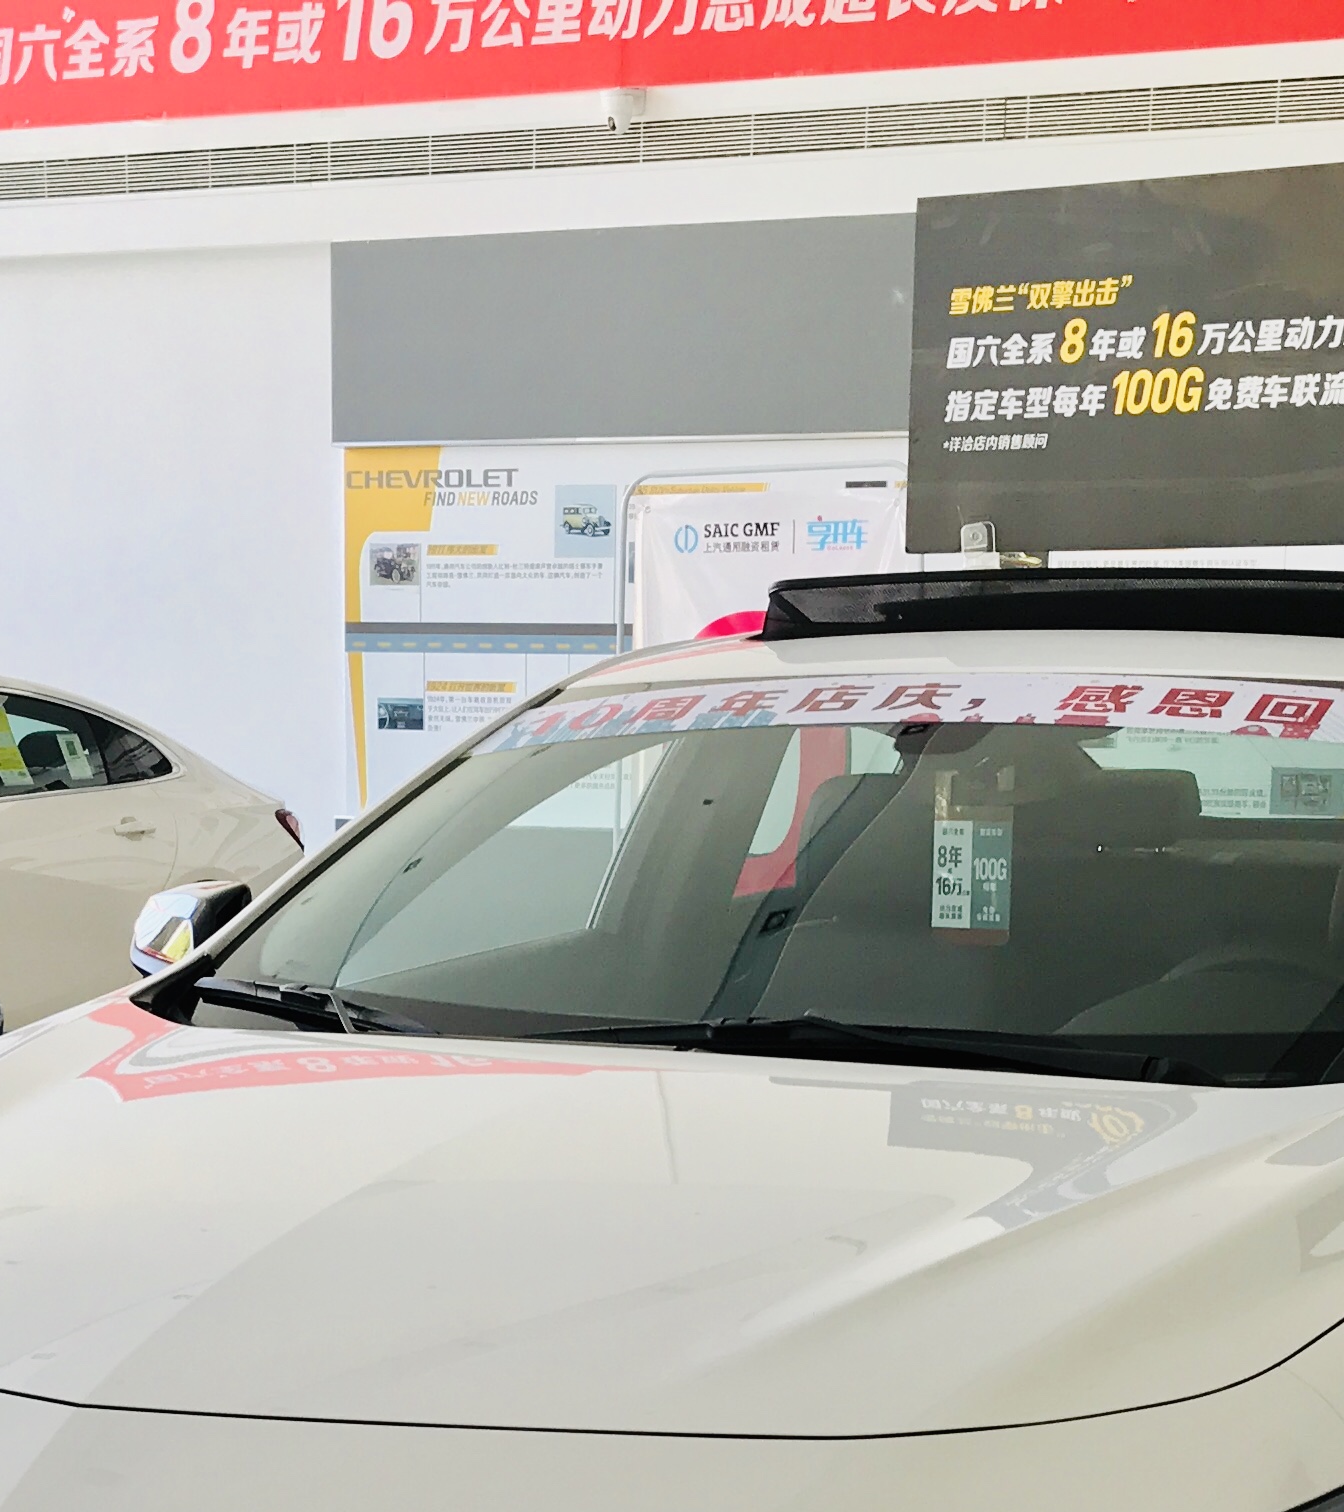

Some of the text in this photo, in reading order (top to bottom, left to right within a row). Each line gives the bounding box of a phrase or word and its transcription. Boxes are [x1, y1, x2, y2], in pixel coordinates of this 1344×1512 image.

[346, 468, 519, 490] CHEVROLET
[423, 490, 539, 507] FIND NEW ROADS
[703, 521, 780, 538] SAIC GMF
[973, 857, 1007, 881] 100G
